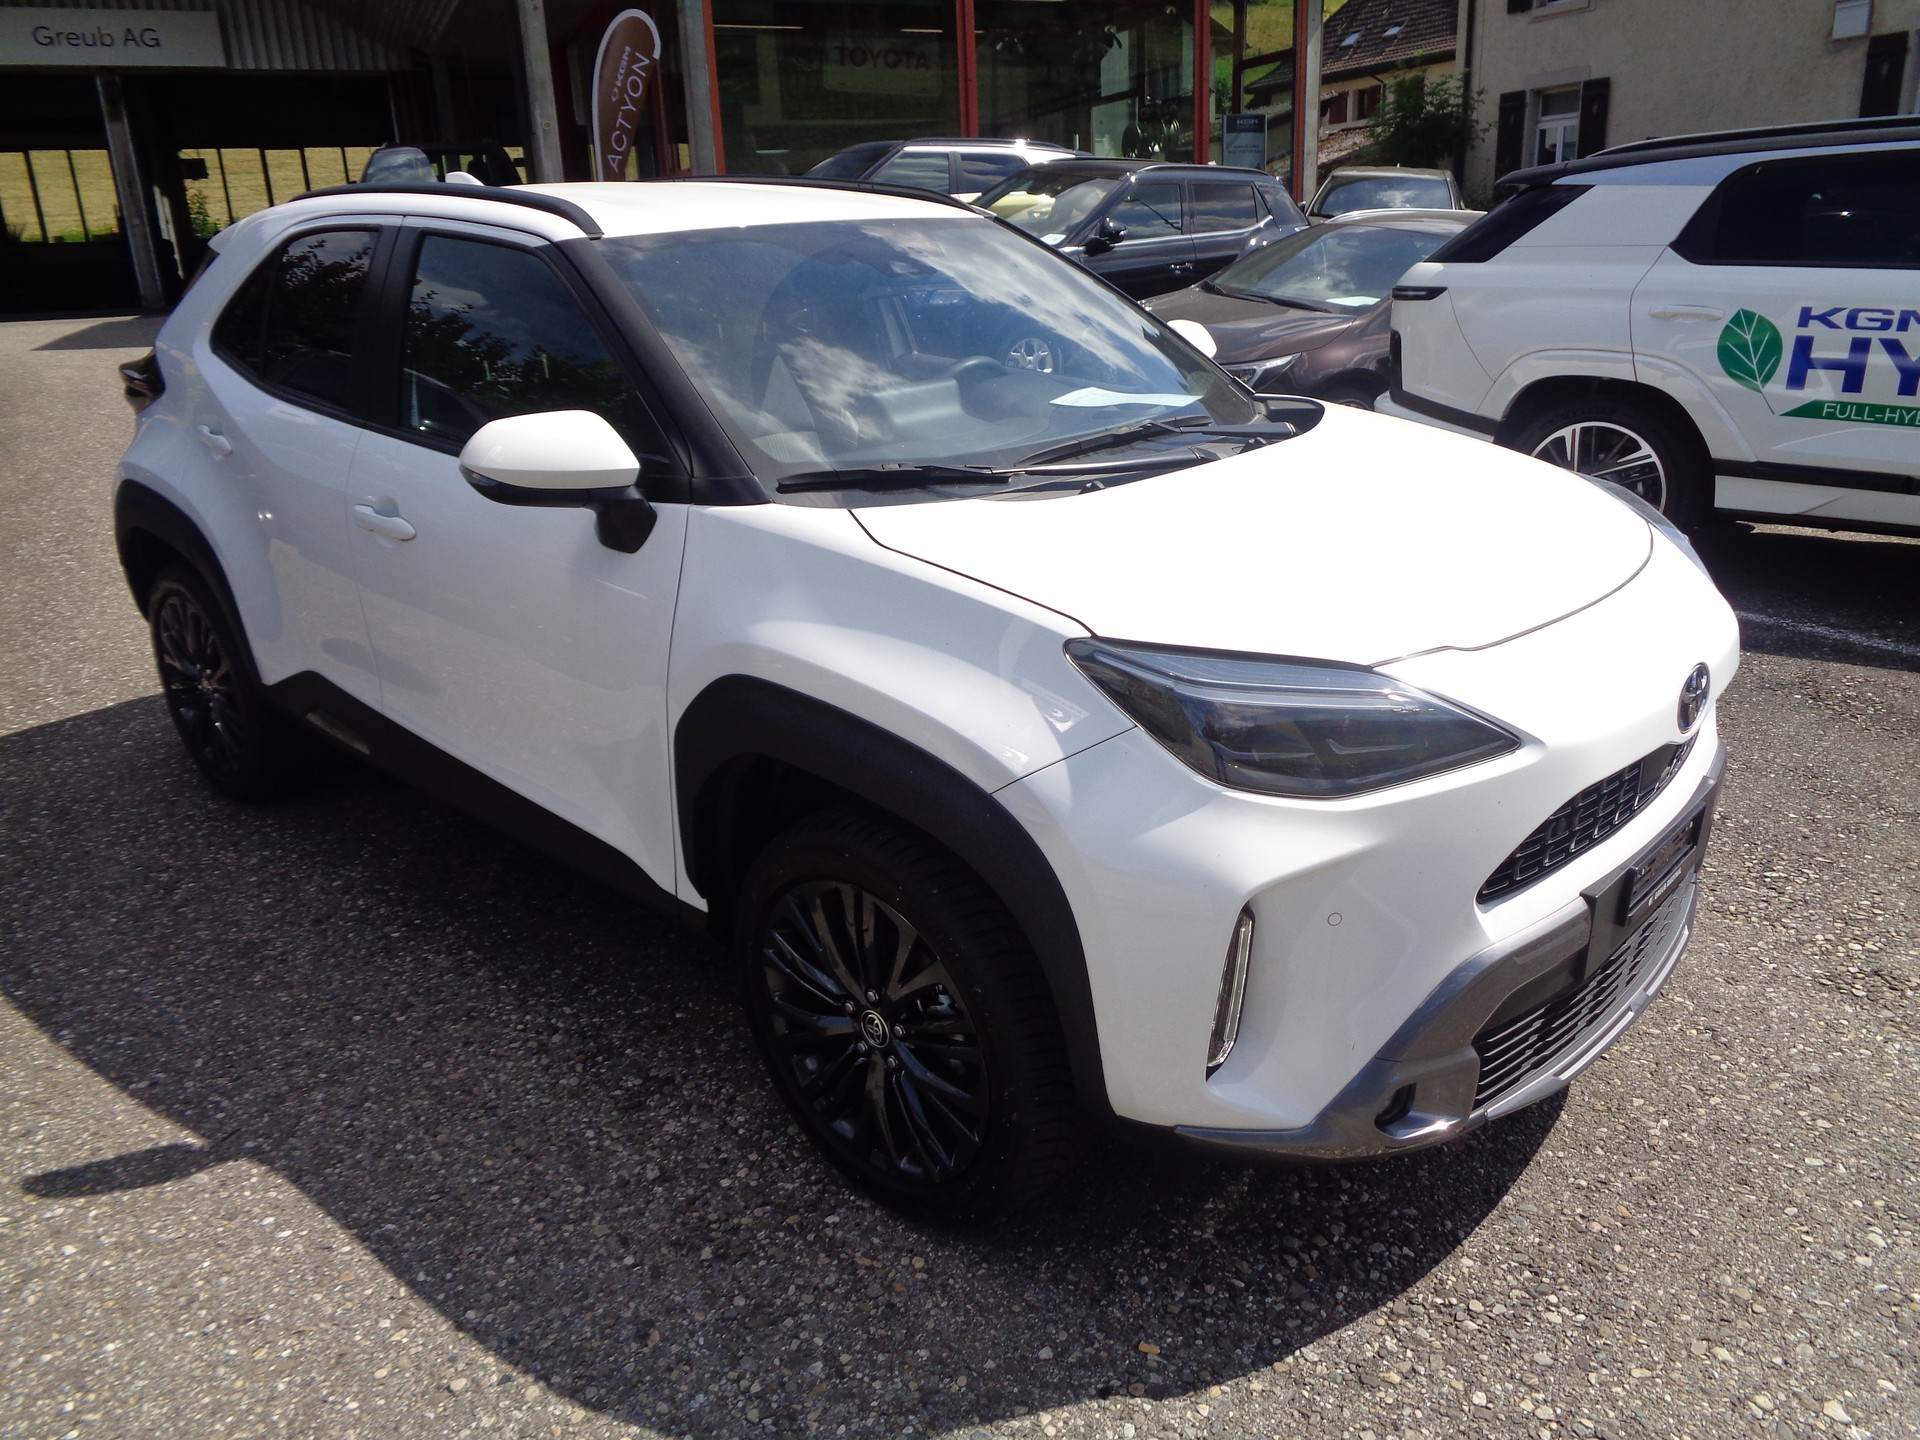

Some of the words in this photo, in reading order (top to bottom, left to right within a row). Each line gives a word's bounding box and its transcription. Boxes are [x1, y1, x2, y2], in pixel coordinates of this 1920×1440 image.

[32, 26, 115, 47] Greub
[123, 28, 161, 48] AG
[834, 46, 930, 70] TOYOTA
[607, 52, 651, 174] ACTYON
